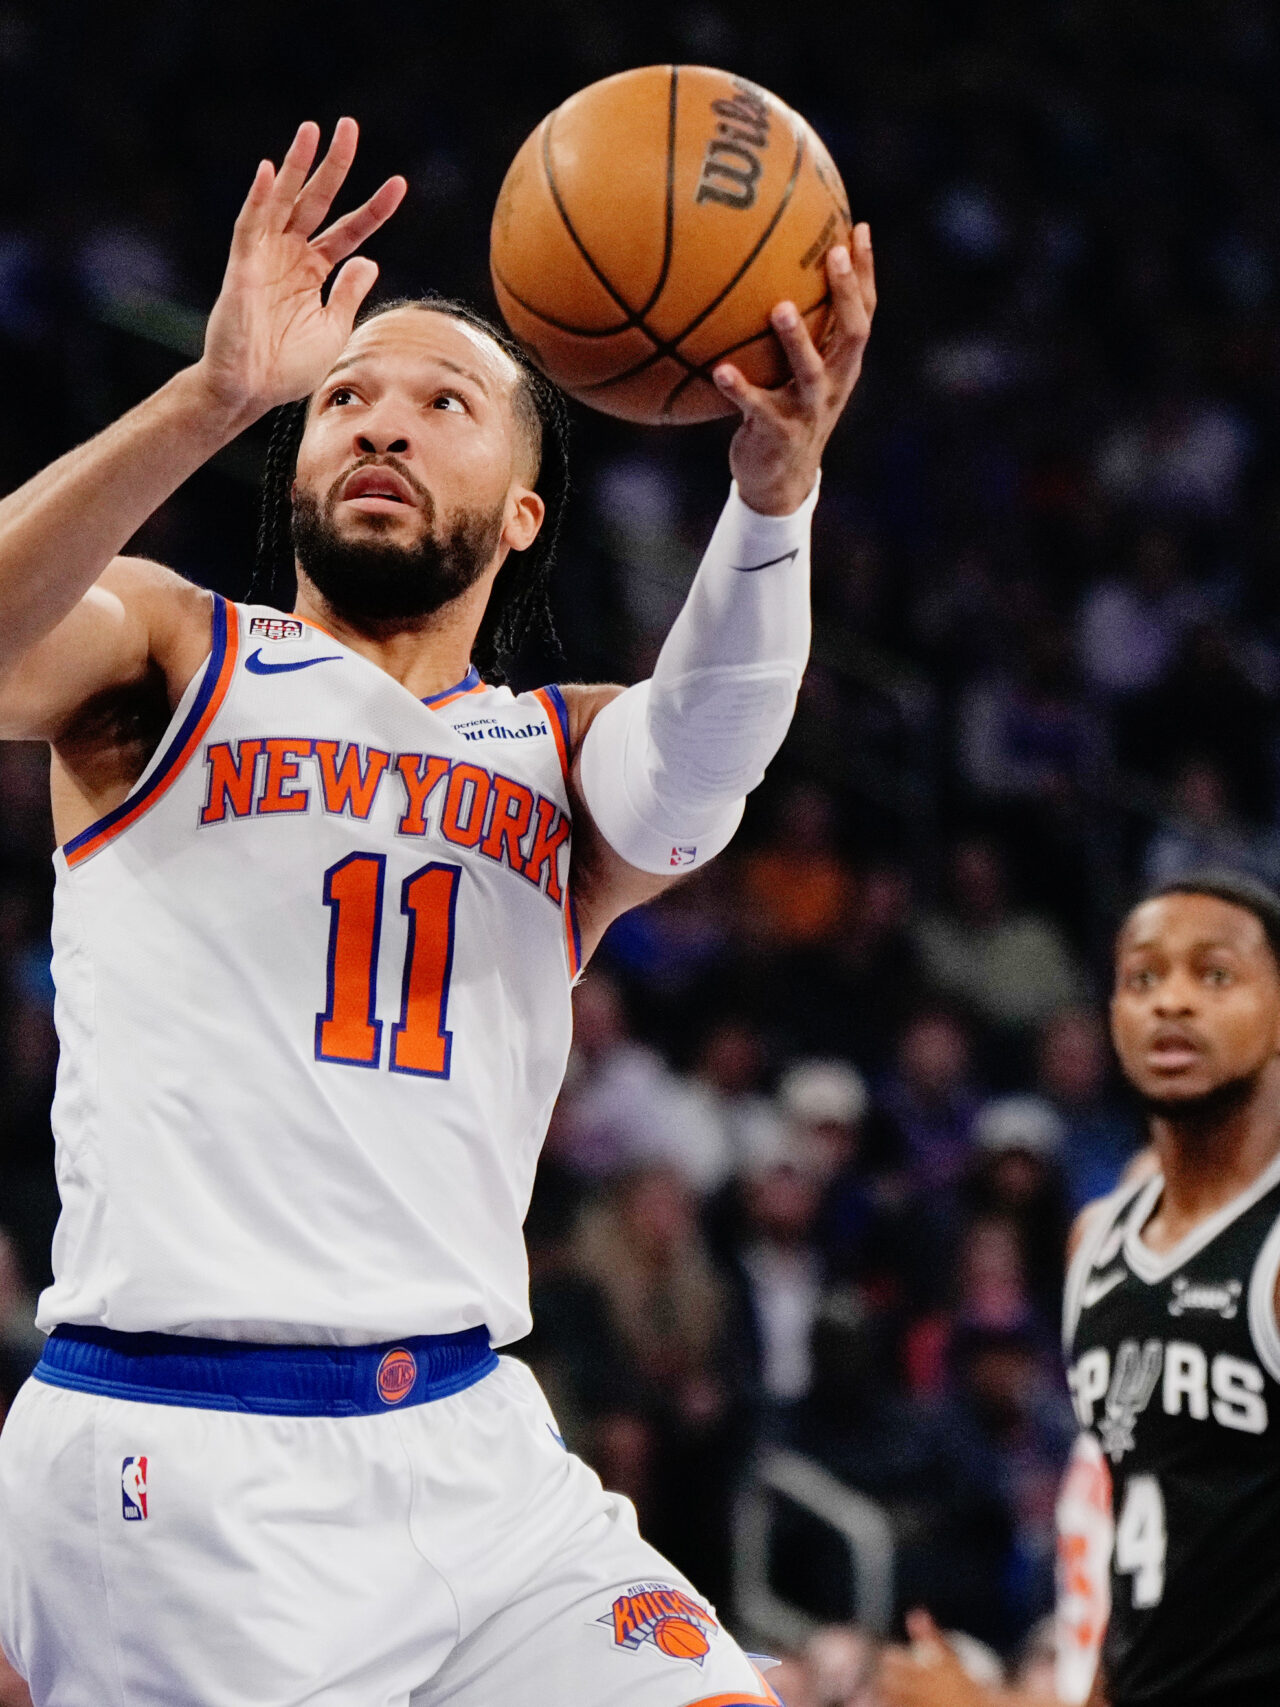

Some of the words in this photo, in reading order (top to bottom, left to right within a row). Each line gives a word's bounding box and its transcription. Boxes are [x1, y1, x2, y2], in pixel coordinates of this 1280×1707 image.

[453, 718, 498, 730] perience
[198, 738, 391, 827] NEW
[395, 752, 572, 909] YORK
[315, 851, 463, 1079] 11
[1068, 1339, 1268, 1455] PURS
[124, 1506, 139, 1518] NBA
[1116, 1472, 1167, 1610] 4
[612, 1589, 719, 1650] KNICKS
[626, 1583, 646, 1596] NEW
[646, 1582, 670, 1592] YORK
